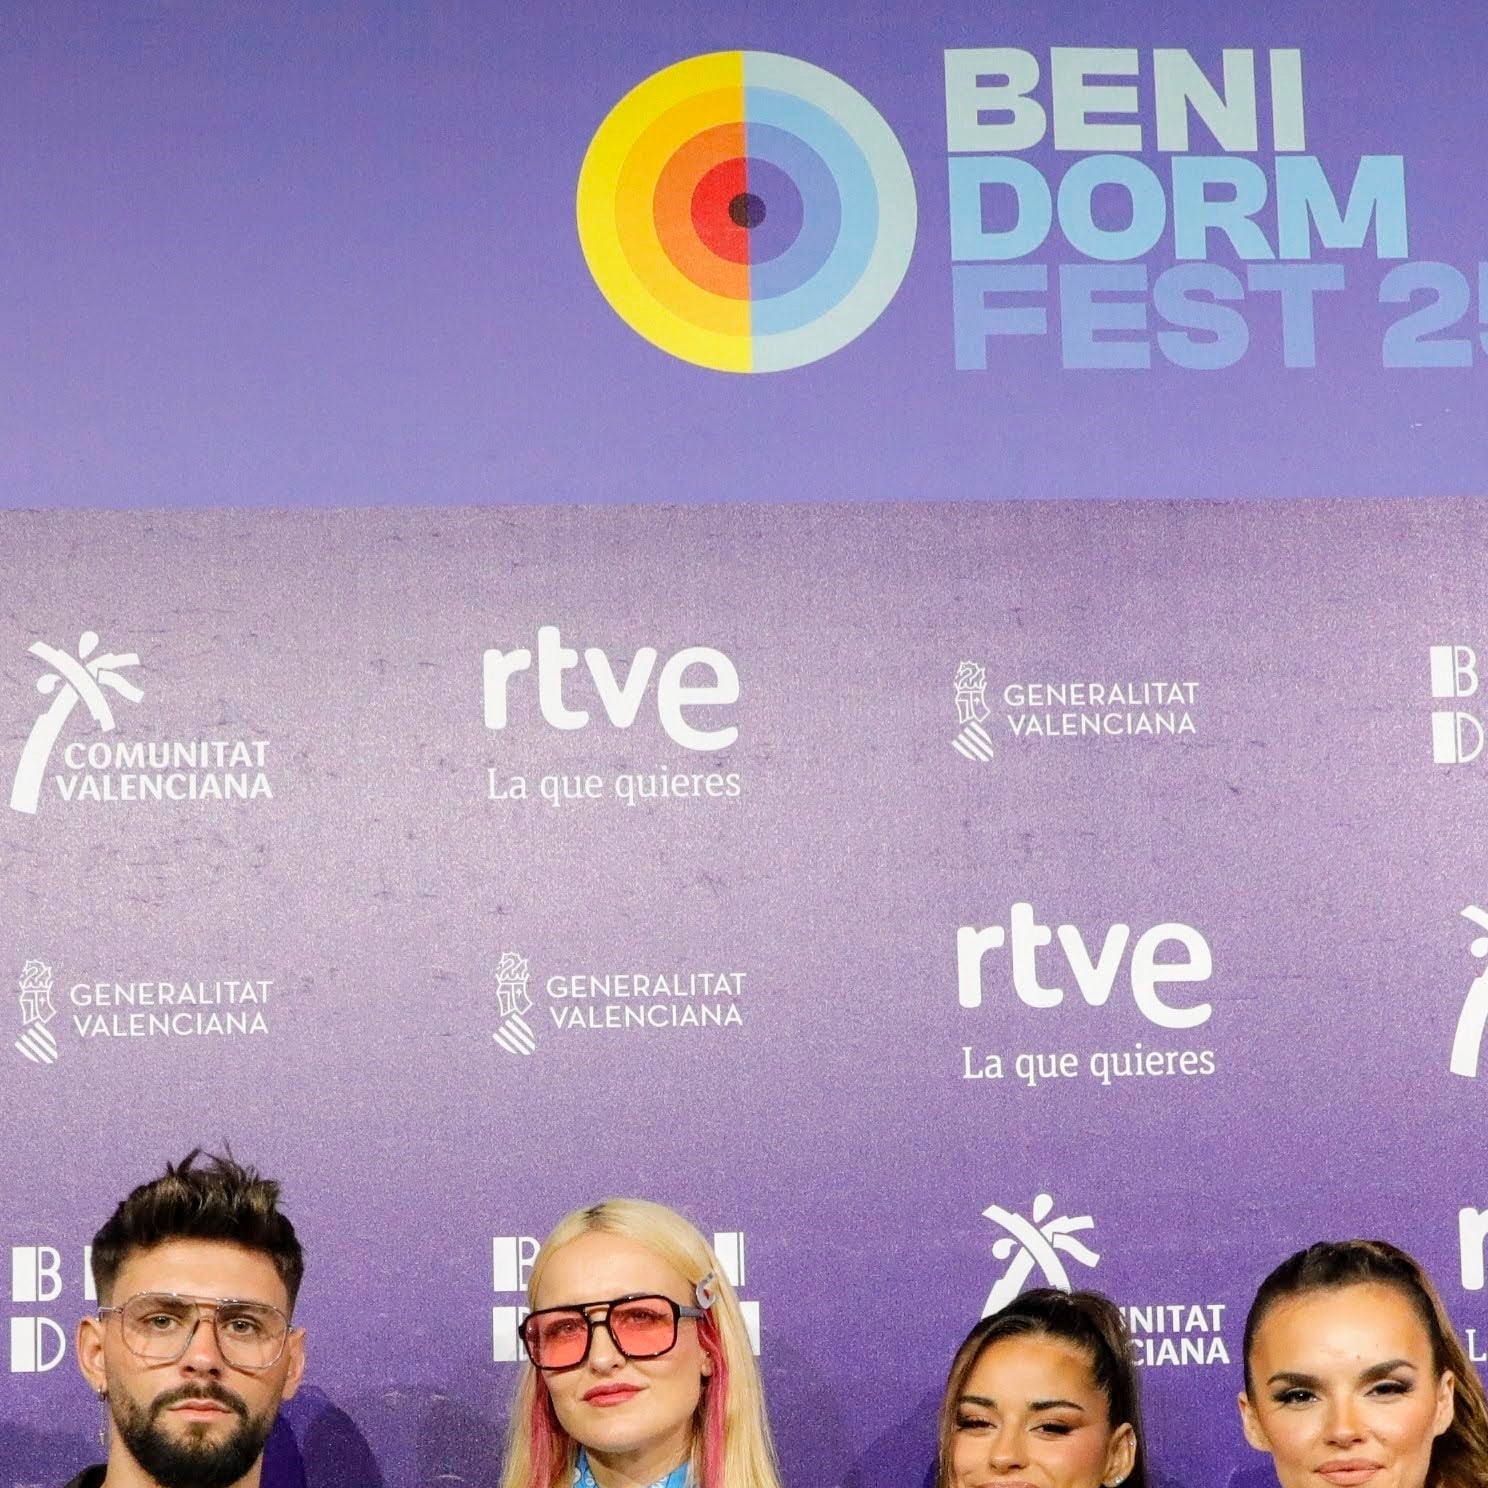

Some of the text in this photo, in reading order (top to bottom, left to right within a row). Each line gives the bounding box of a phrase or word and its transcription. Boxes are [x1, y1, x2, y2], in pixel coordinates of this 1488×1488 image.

[944, 48, 1306, 152] BENI
[949, 154, 1409, 261] DORM
[951, 262, 1345, 370] FEST
[483, 626, 740, 751] rtve
[1003, 682, 1200, 709] GENERALITAT
[1007, 713, 1198, 737] VALENCIANA
[63, 740, 270, 769] COMUNITAT
[56, 773, 273, 802] VALENCIANA
[487, 765, 741, 808] La que quieres
[956, 902, 1213, 1028] rtve
[70, 981, 273, 1007] GENERALITAT
[546, 972, 747, 998] GENERALITAT
[73, 1012, 269, 1037] VALENCIANA
[550, 1004, 743, 1029] VALENCIANA
[962, 1043, 1215, 1086] La que quieres
